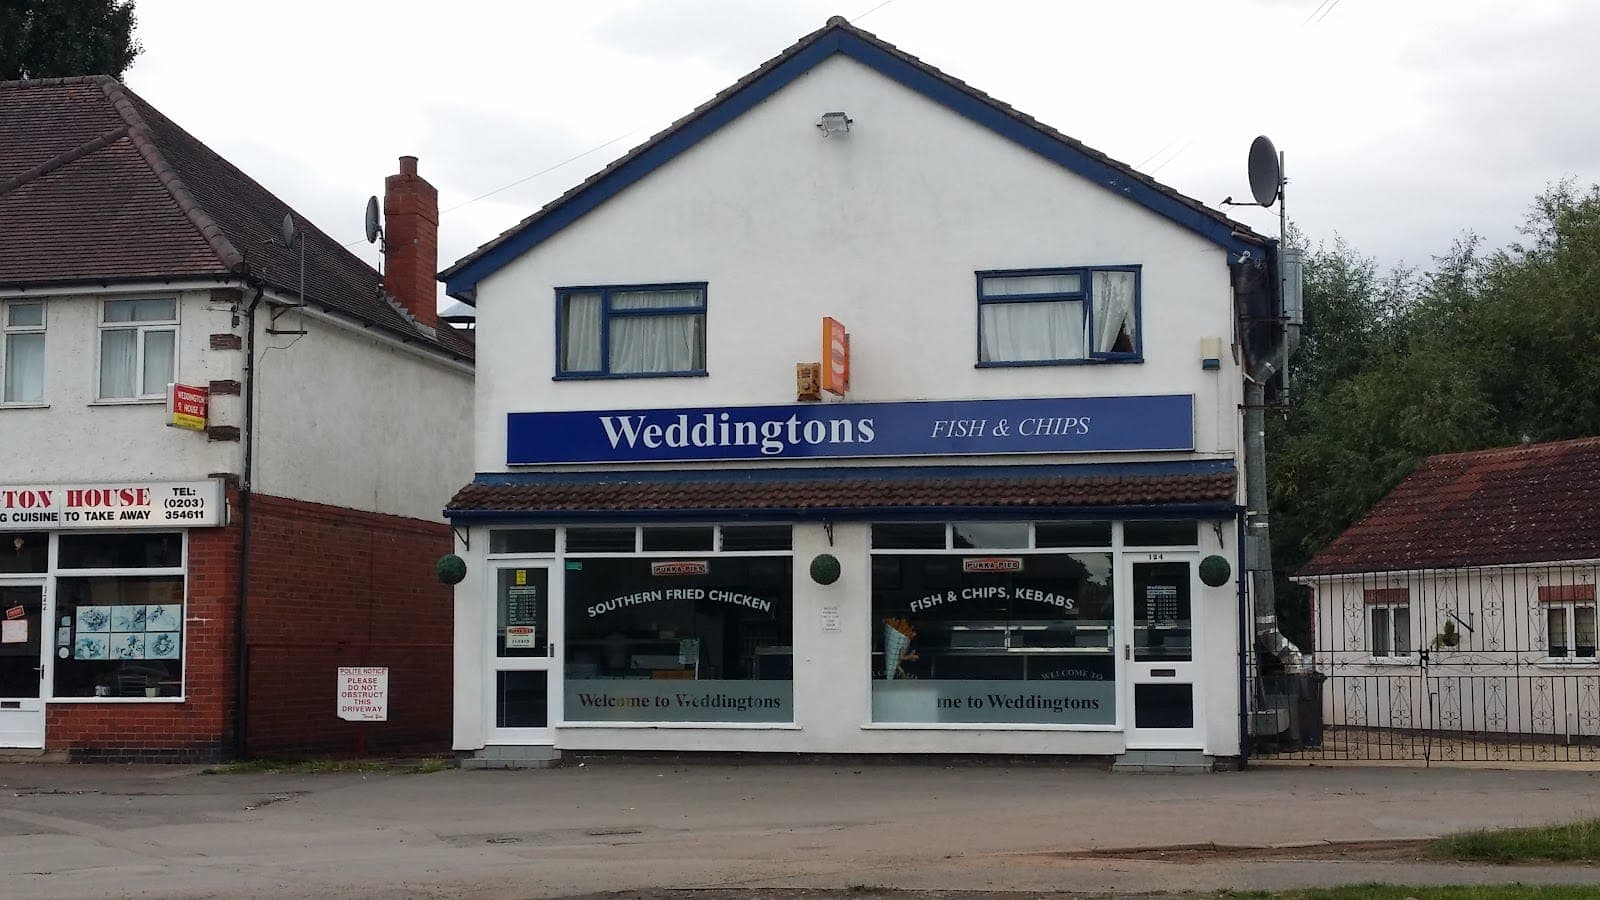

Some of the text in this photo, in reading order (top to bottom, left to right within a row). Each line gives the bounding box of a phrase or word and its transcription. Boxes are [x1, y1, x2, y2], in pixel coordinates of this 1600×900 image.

[599, 412, 876, 455] Weddingtons
[930, 416, 1092, 438] FISH & CHIPS
[2, 488, 151, 508] TON HOUSE
[172, 487, 196, 496] TEL:
[164, 498, 204, 509] (0203)
[12, 512, 58, 522] CUISINE
[64, 512, 80, 521] TO
[85, 511, 115, 521] TAKE
[119, 510, 151, 520] AWAY
[165, 511, 204, 520] 354611
[587, 589, 771, 617] SOUTHERN FRIED CHICKEN
[910, 587, 1075, 613] FISH & CHIPS, KEBABS
[1041, 668, 1105, 680] WELCOME TO
[578, 693, 781, 712] Welcome to Weddingtons
[967, 696, 983, 709] to
[986, 694, 1100, 712] Weddingtons
